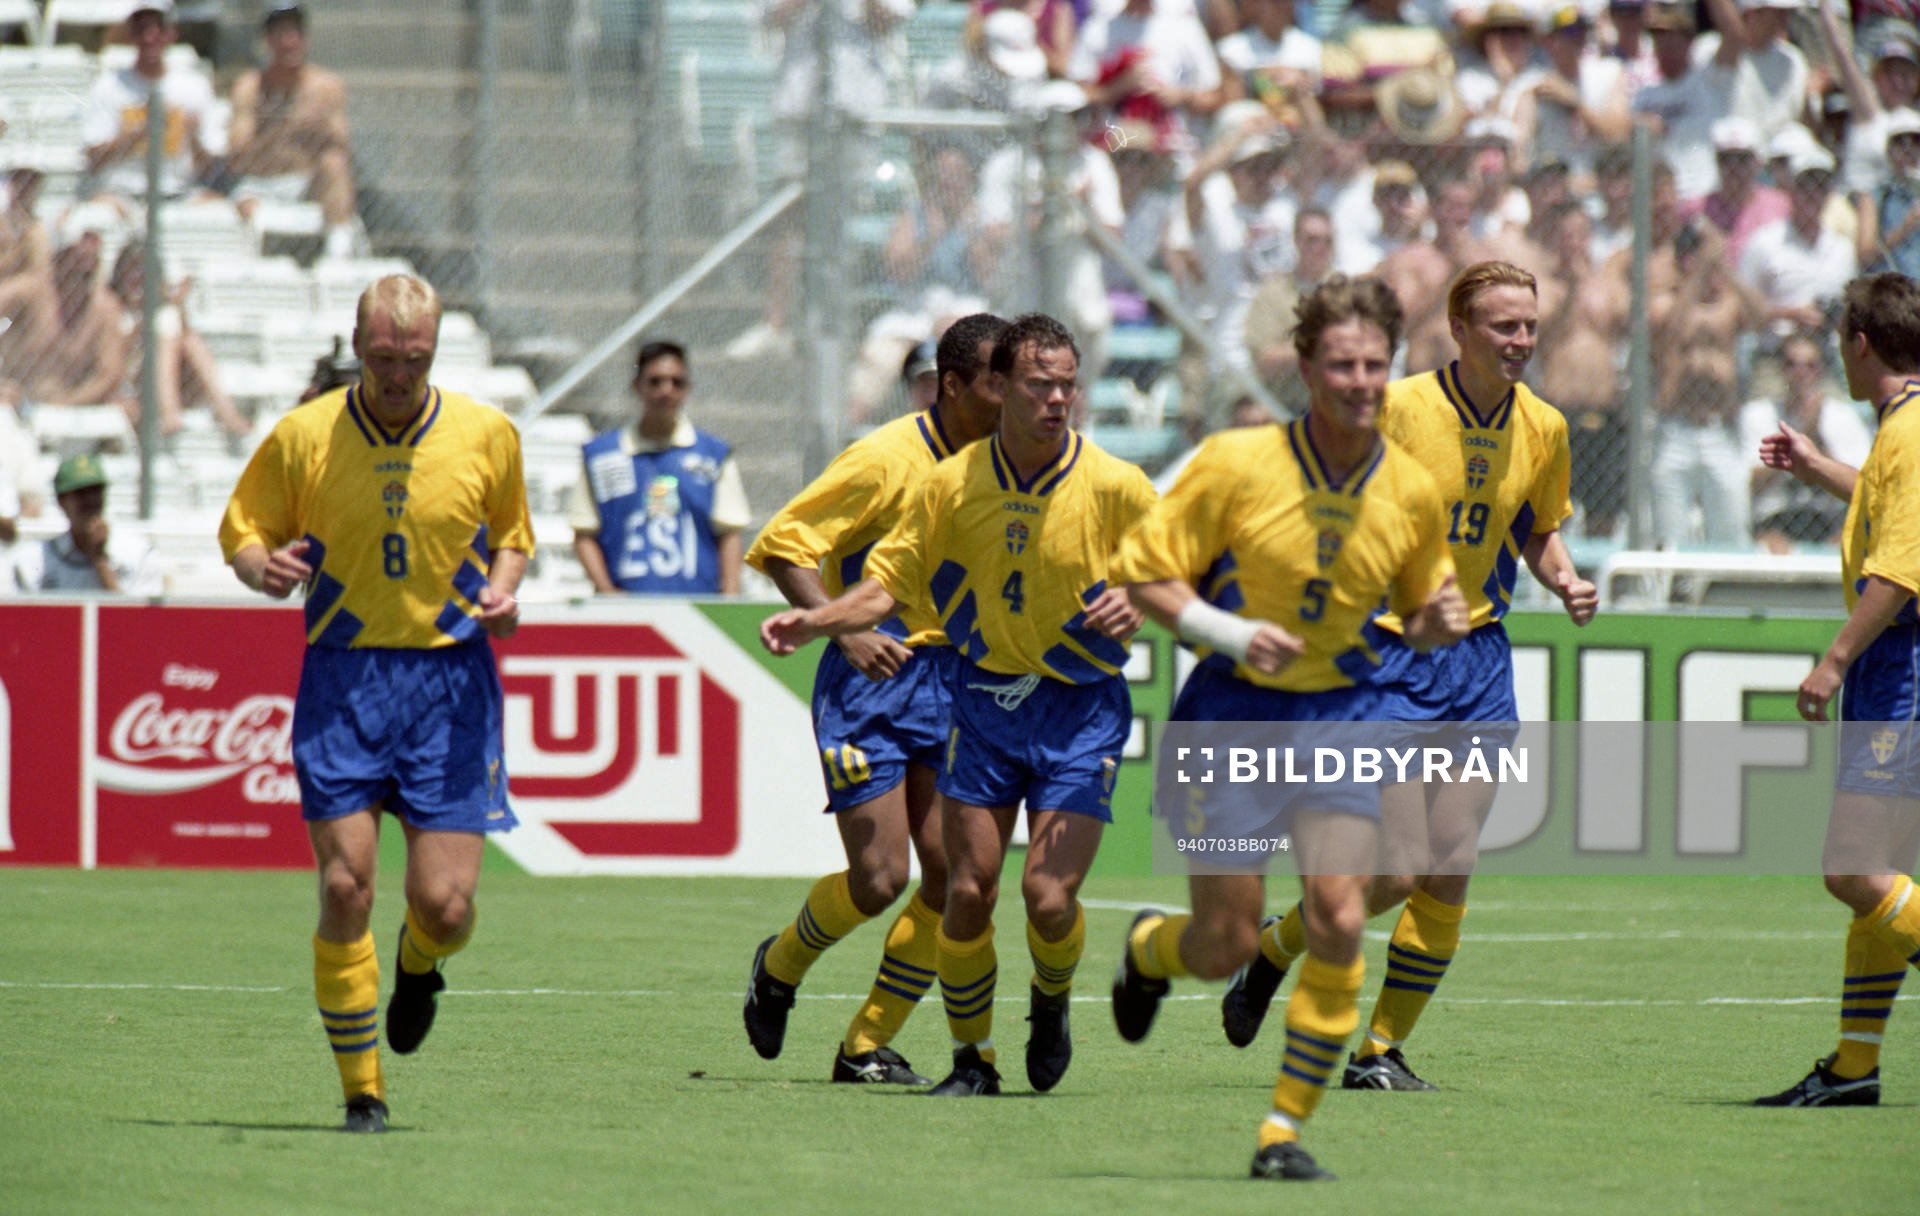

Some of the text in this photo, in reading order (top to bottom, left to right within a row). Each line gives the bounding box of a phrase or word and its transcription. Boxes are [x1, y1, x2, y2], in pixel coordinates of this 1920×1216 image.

[1464, 437, 1498, 450] adidas
[1003, 501, 1040, 514] adidas
[1447, 500, 1490, 545] 19
[382, 532, 408, 579] 8
[1001, 570, 1024, 615] 4
[1299, 578, 1333, 623] 5
[162, 662, 220, 690] Enjoy
[109, 692, 297, 764] Coca-Col
[824, 743, 871, 791] 10
